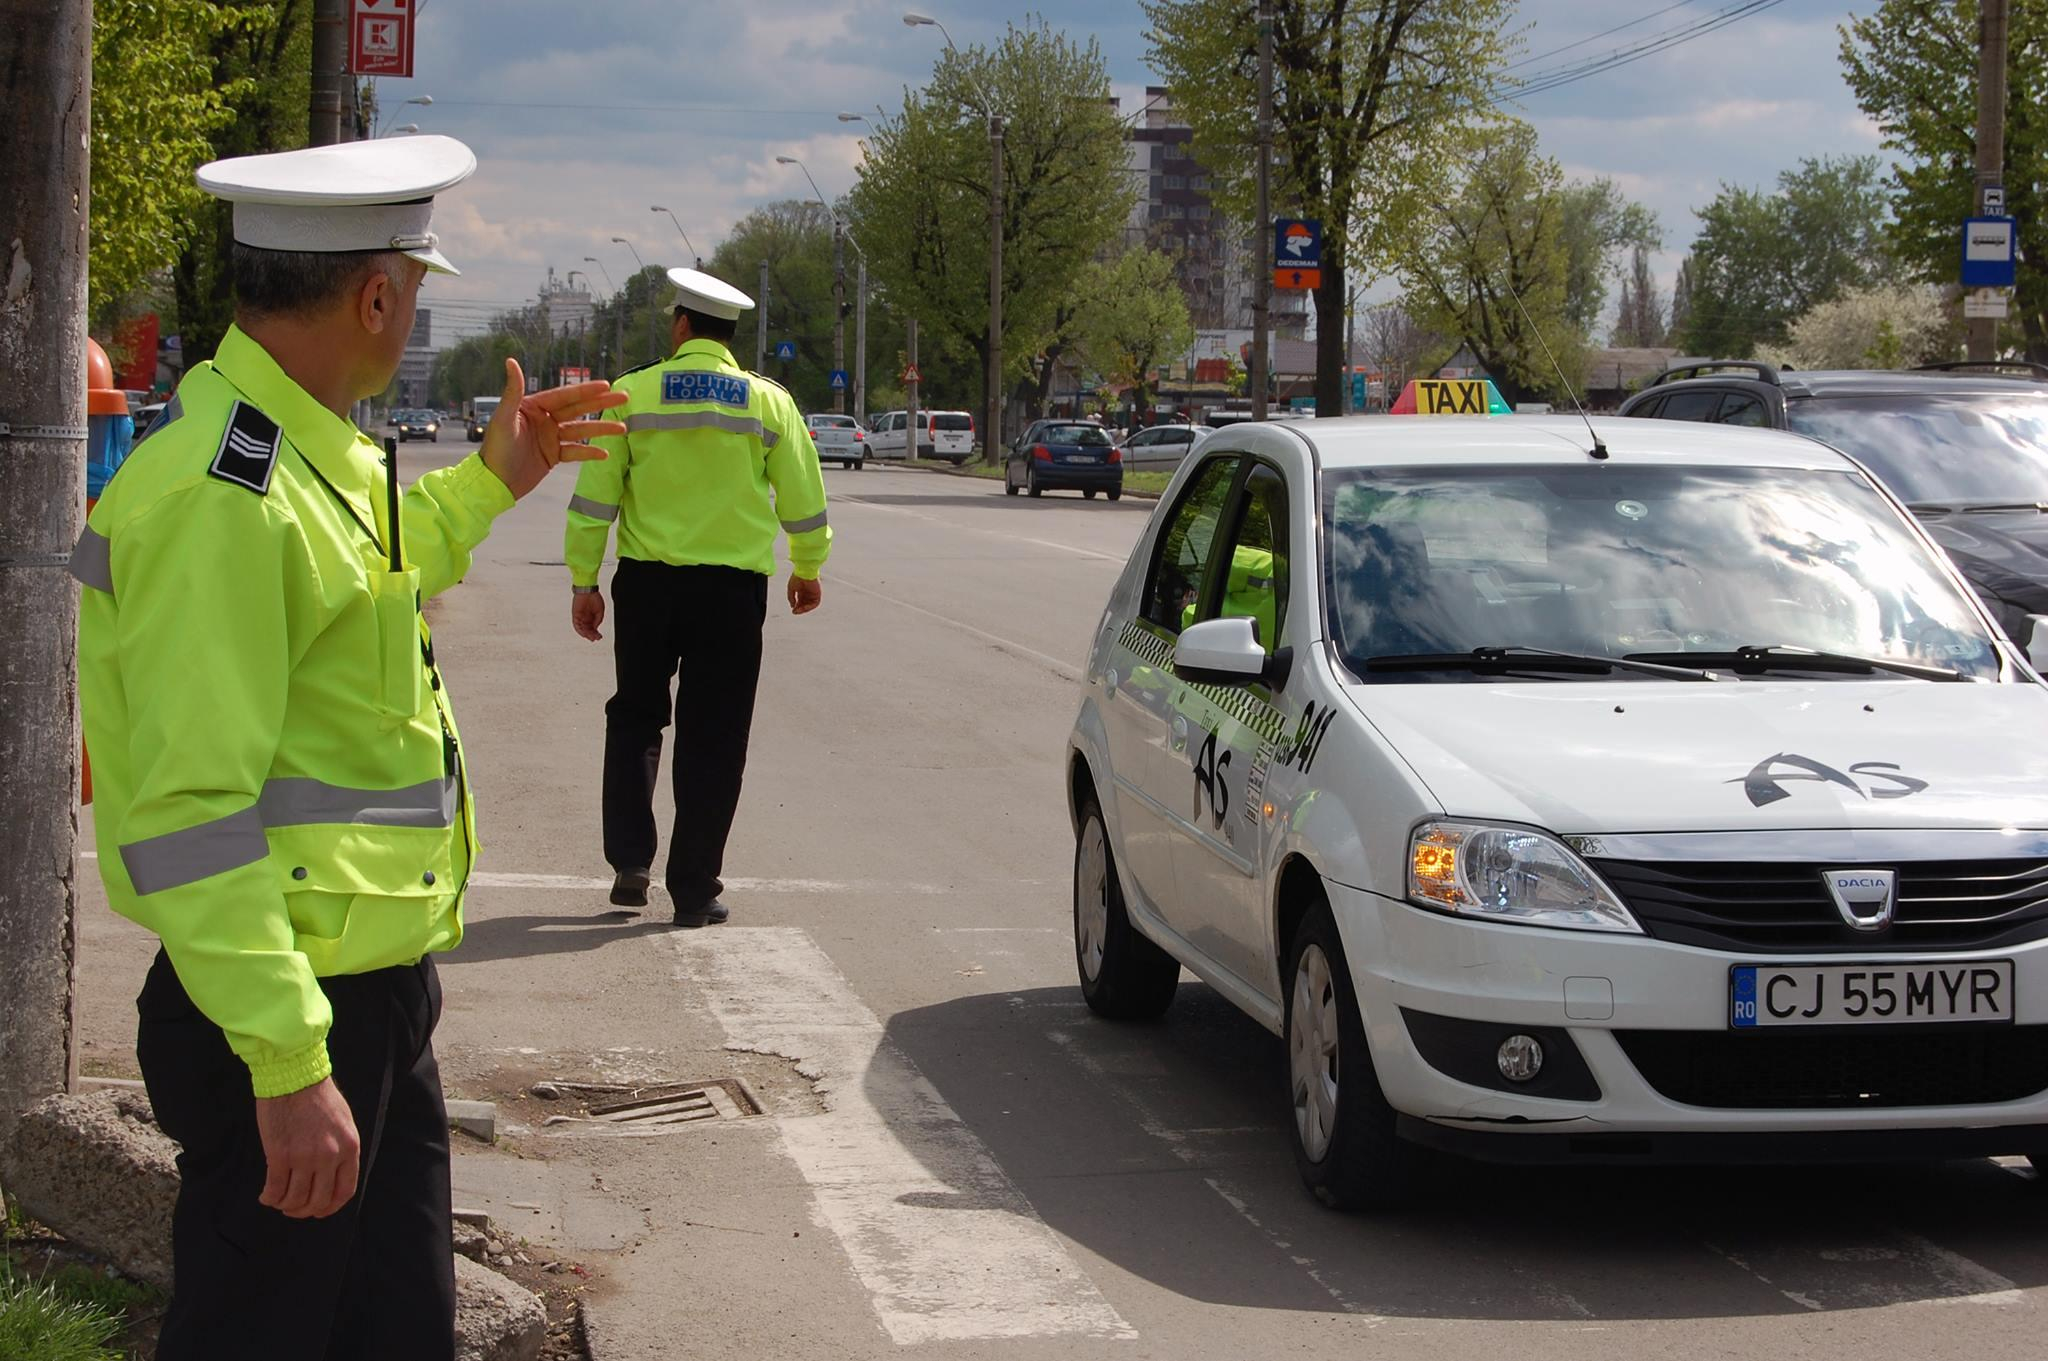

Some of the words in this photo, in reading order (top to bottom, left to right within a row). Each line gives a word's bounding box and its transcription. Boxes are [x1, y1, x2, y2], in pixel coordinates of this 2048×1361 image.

[1983, 206, 2004, 216] TAXI
[670, 388, 740, 402] LOCALA
[1421, 382, 1485, 414] TAXI
[1285, 700, 1338, 775] 941
[1837, 878, 1886, 888] DACIA
[1766, 973, 1824, 1019] CJ
[1735, 1001, 1756, 1019] RO
